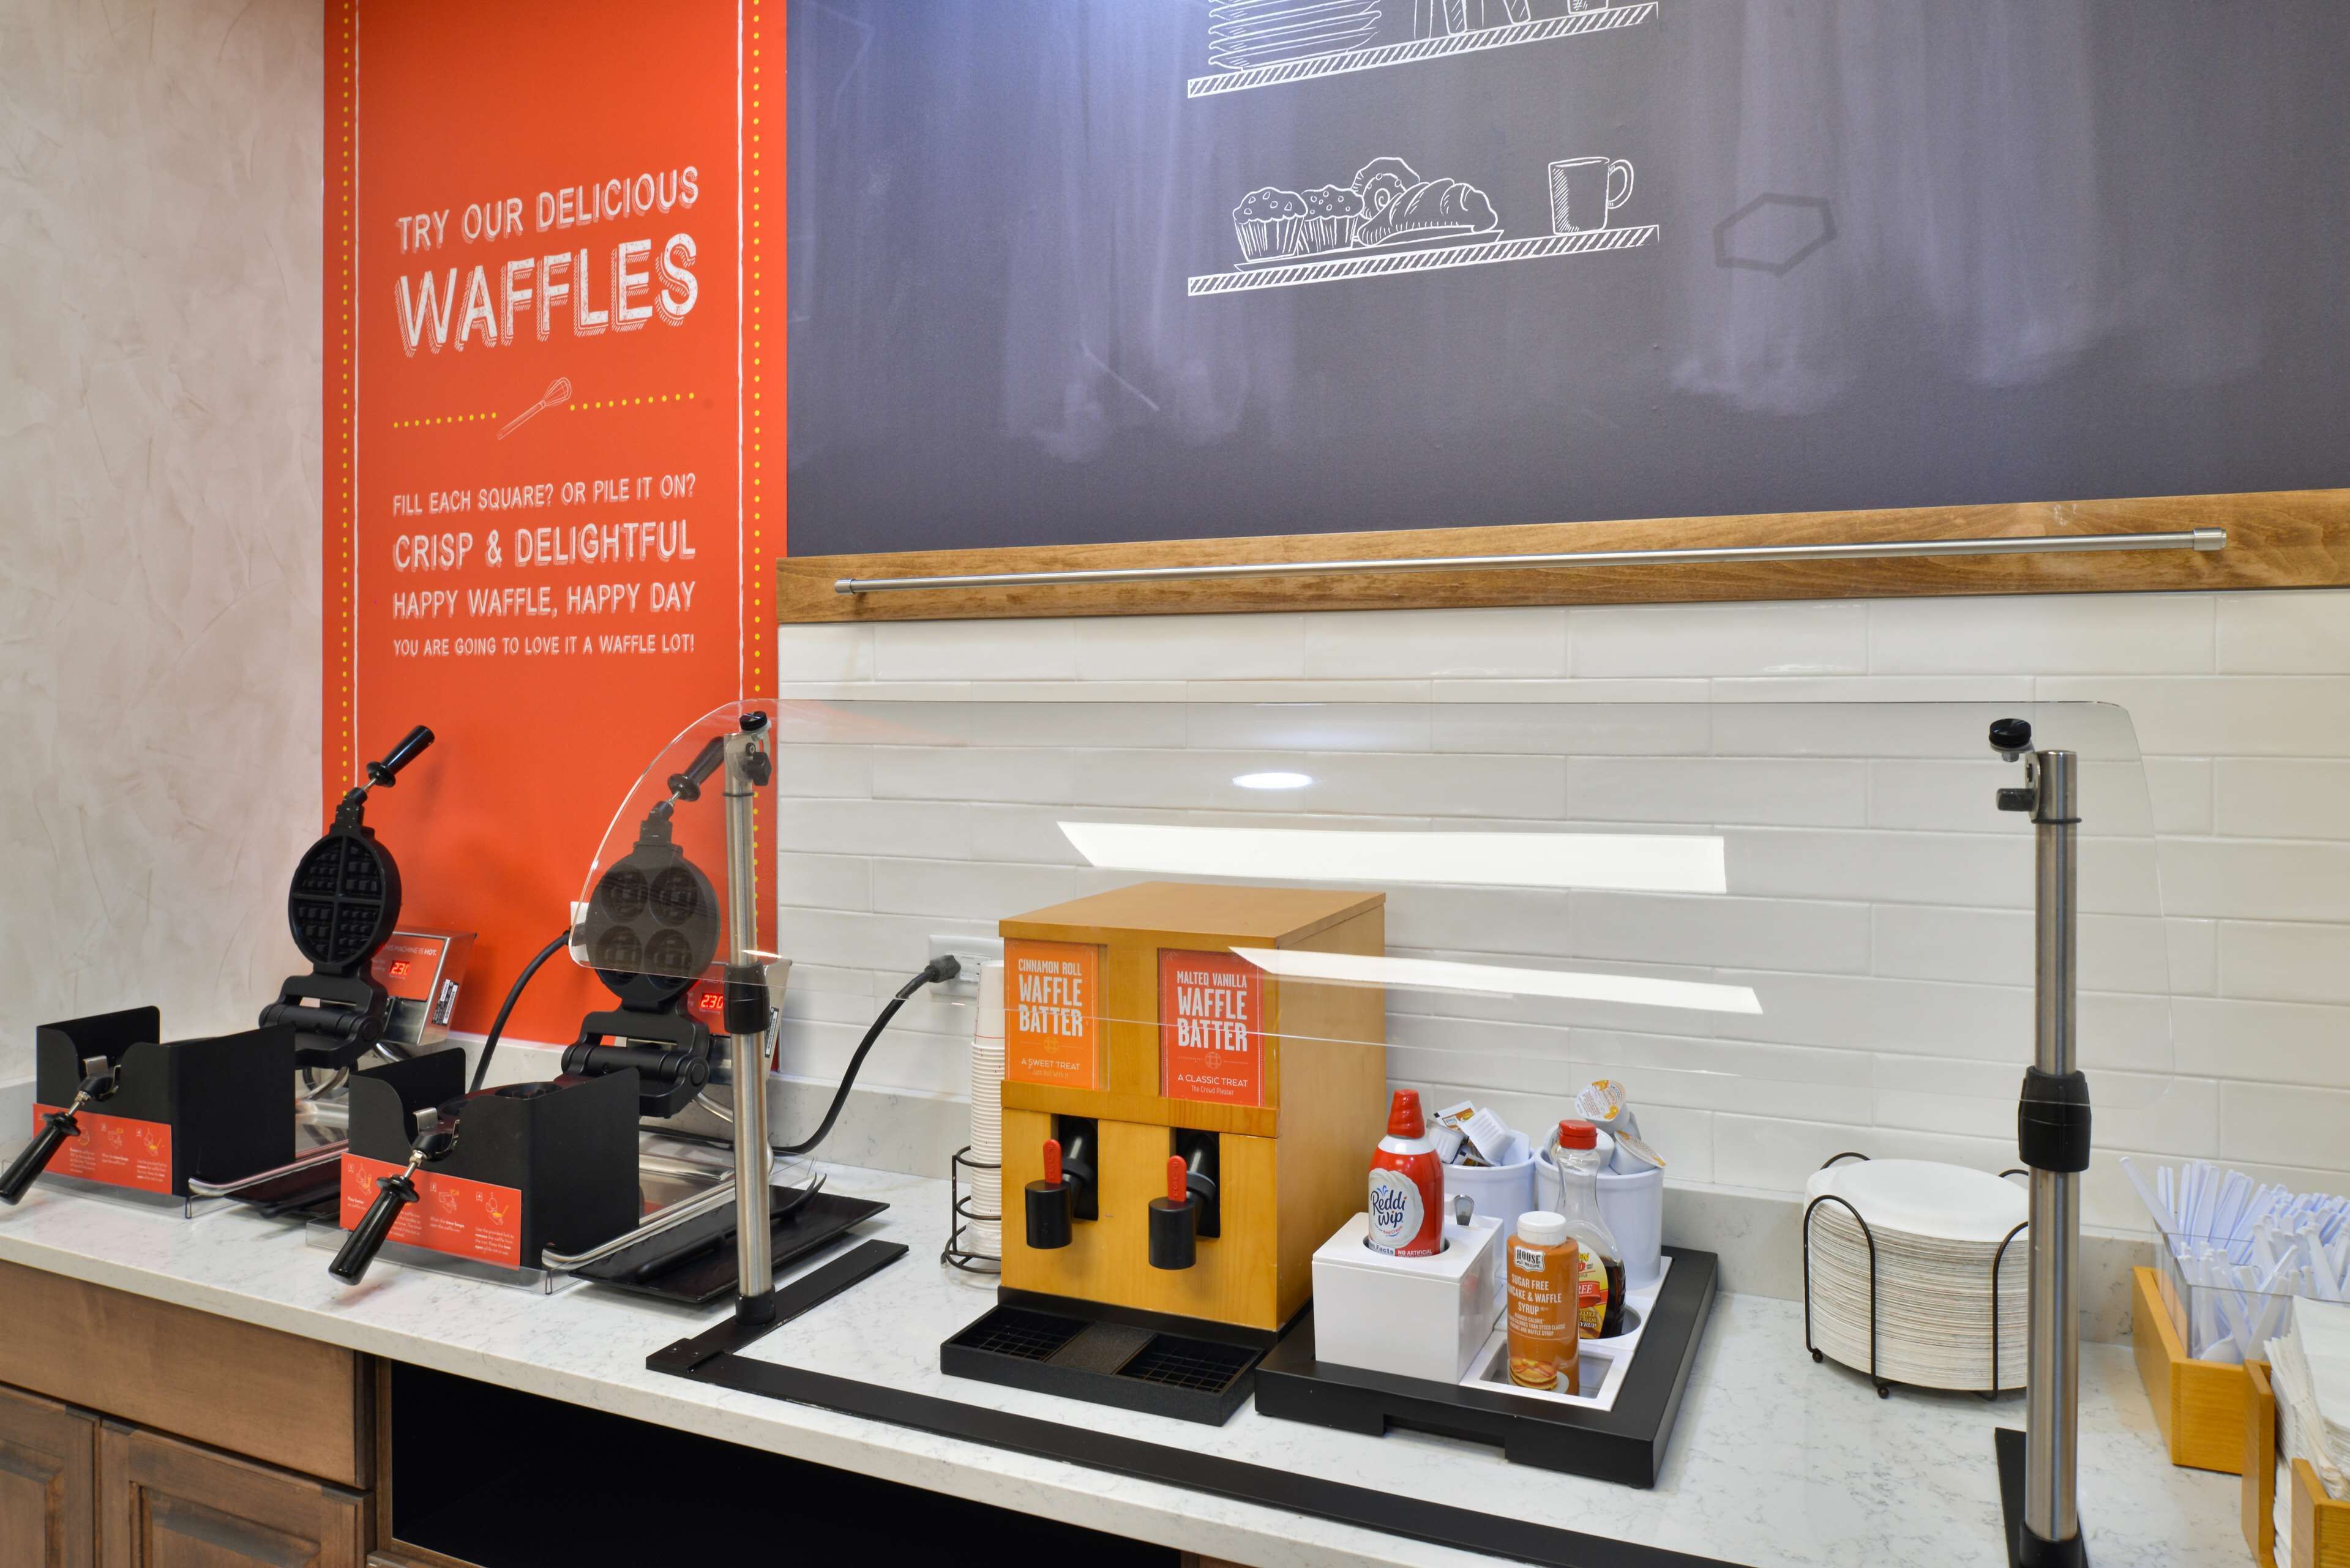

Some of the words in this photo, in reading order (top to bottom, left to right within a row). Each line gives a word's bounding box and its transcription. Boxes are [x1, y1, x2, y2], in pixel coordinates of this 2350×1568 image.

[395, 209, 449, 254] TRY
[462, 198, 523, 244] OUR
[536, 166, 698, 233] DELICIOUS
[394, 233, 698, 357] WAFFLES
[393, 494, 422, 516] FILL
[428, 490, 471, 513] EACH
[477, 483, 553, 509] SQUARE?
[561, 482, 586, 504] OR
[593, 479, 629, 502] PILE
[637, 477, 653, 499] IT
[660, 473, 695, 499] ON?
[393, 532, 473, 572] CRISP
[485, 529, 502, 567] &
[514, 520, 695, 567] DELIGHTFUL
[393, 590, 458, 619] HAPPY
[467, 586, 558, 618] WAFFLE,
[566, 583, 640, 613] HAPPY
[650, 581, 695, 611] DAY
[394, 639, 418, 657] YOU
[423, 638, 449, 656] ARE
[454, 637, 496, 655] GOING
[502, 637, 519, 655] TO
[525, 637, 559, 654] LOVE
[564, 636, 577, 654] IT
[582, 636, 593, 654] A
[599, 635, 656, 653] WAFFLE
[661, 634, 695, 653] LOT!
[1018, 958, 1059, 974] CINNAMON
[1062, 962, 1082, 976] ROLL
[1019, 974, 1082, 1007] WAFFLE
[1177, 971, 1209, 985] MALTED
[1212, 973, 1247, 988] VANILLA
[1177, 987, 1248, 1020] WAFFLE
[1019, 1004, 1083, 1037] BATTER
[1177, 1018, 1248, 1051] BATTER
[1028, 1058, 1054, 1067] SWEET
[1056, 1061, 1080, 1070] TREAT
[1185, 1075, 1220, 1085] CLASSIC
[1221, 1078, 1248, 1088] TREAT
[1371, 1189, 1407, 1215] Reddi
[1517, 1249, 1541, 1264] HOUSE
[1511, 1274, 1530, 1288] SUGAR
[1532, 1280, 1549, 1291] FREE
[1579, 1285, 1593, 1294] REE
[1518, 1302, 1539, 1315] SYRUP
[1527, 1291, 1533, 1302] &
[1535, 1293, 1562, 1303] WAFFLE
